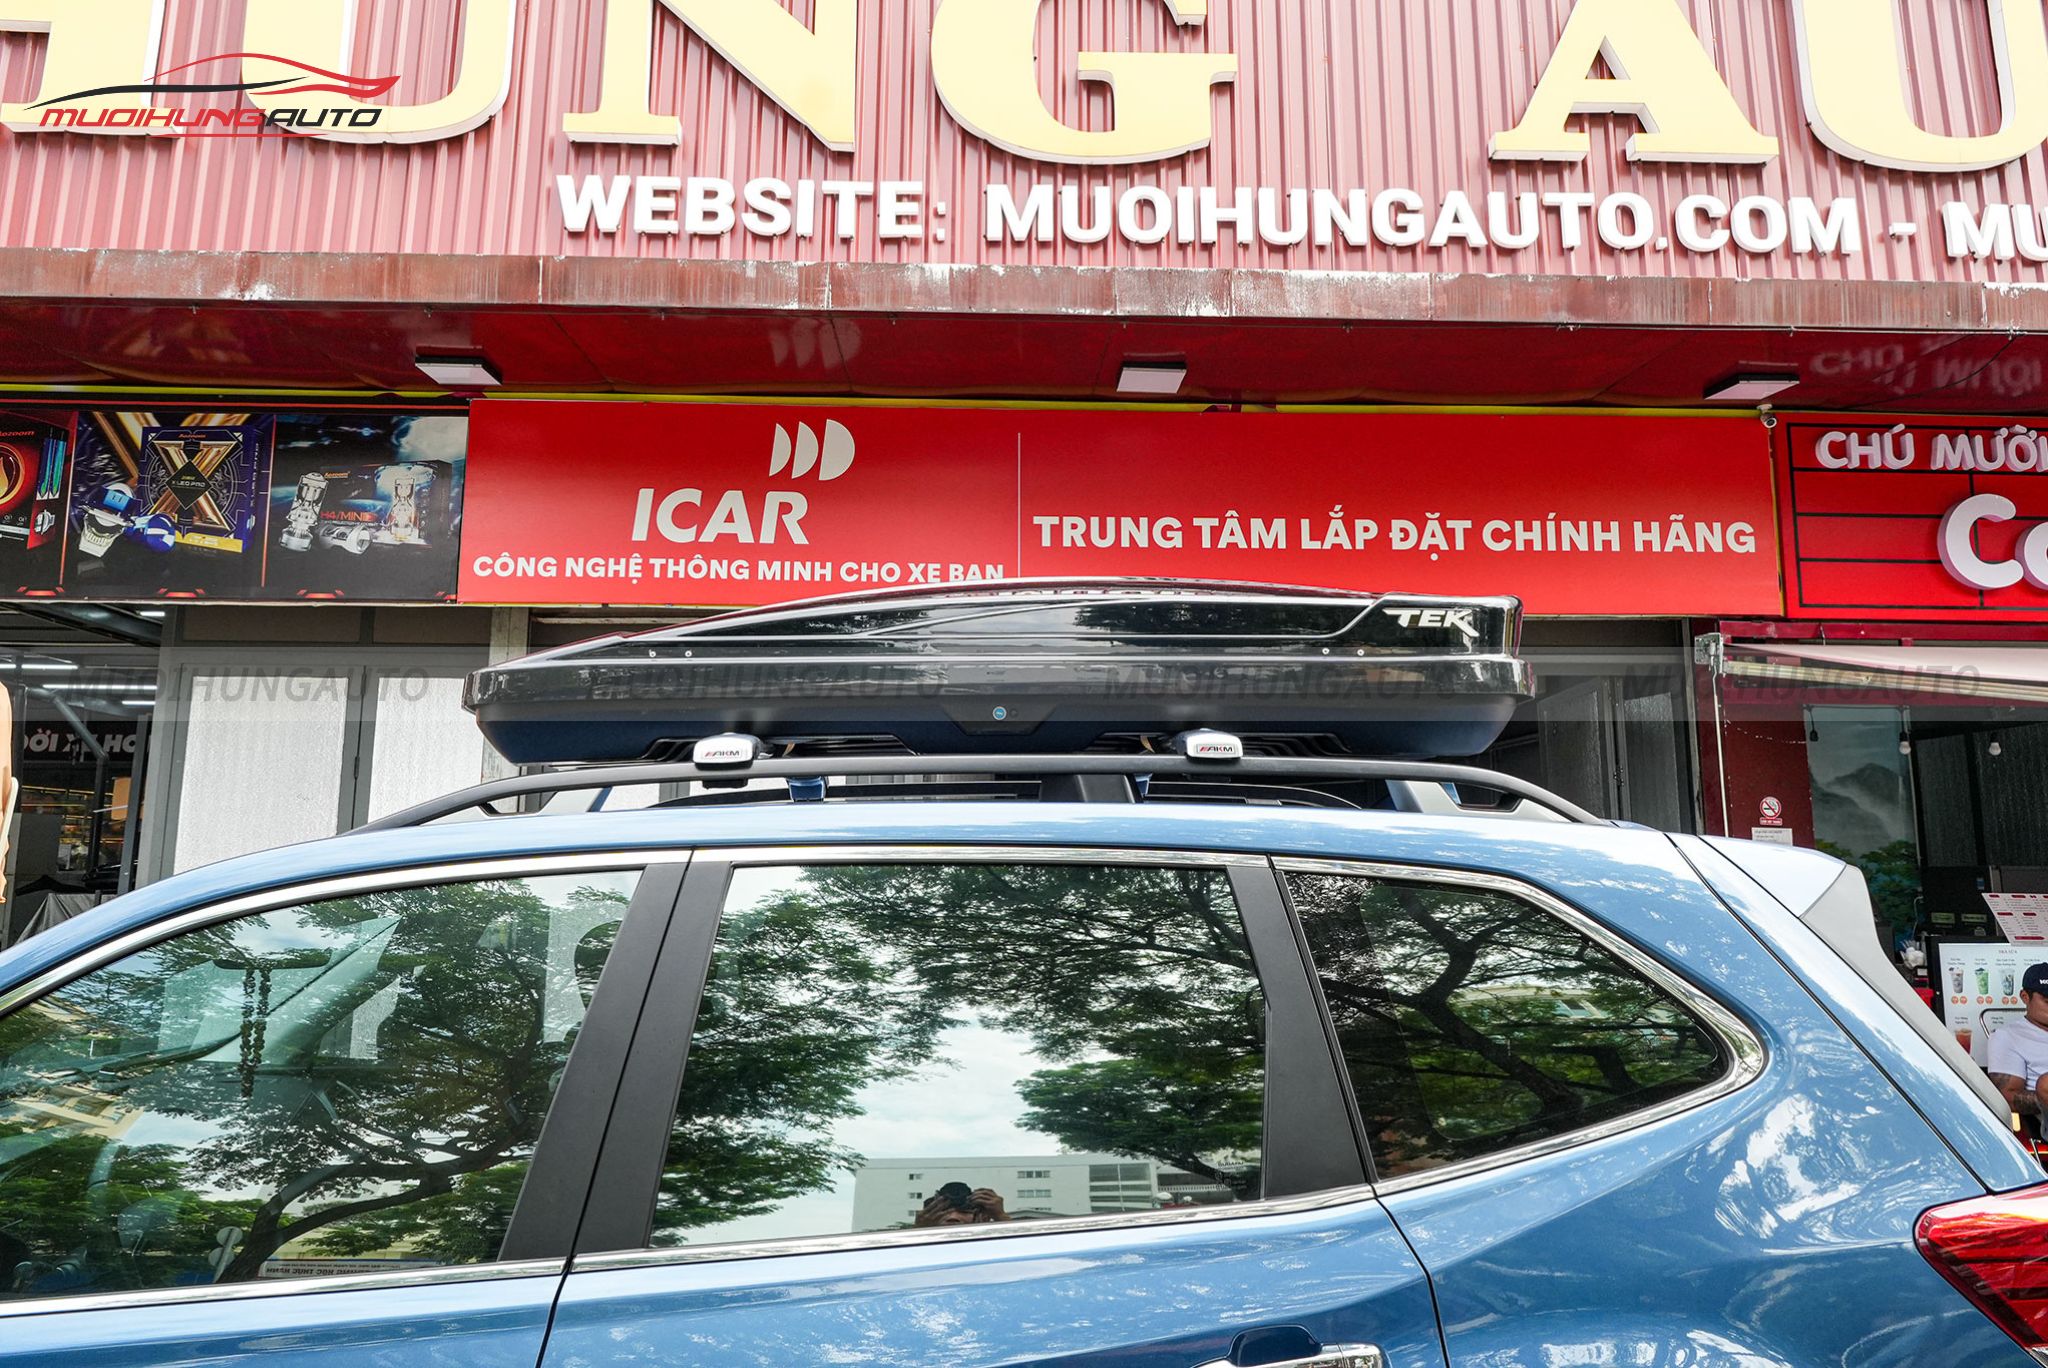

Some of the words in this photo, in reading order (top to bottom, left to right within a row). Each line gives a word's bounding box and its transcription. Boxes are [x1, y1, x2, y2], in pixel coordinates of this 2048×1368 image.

[556, 174, 946, 242] WEBSITE:
[984, 183, 1862, 255] MUOIHUNGAUTO.COM
[1942, 201, 2048, 262] MU
[1815, 423, 1915, 469] CHÚ
[632, 488, 809, 544] ICAR
[1033, 515, 1183, 550] TRUNG
[1194, 511, 1287, 550] TÂM
[1301, 505, 1378, 550] LẮP
[1389, 512, 1472, 561] ĐẶT
[1481, 511, 1620, 552] CHÍNH
[1634, 514, 1756, 553] HÃNG
[473, 552, 558, 578] CÔNG
[565, 553, 642, 584] NGHỆ
[649, 554, 749, 580] THÔNG
[757, 561, 832, 582] MINH
[840, 562, 901, 583] CHO
[908, 563, 941, 583] XE
[1382, 607, 1480, 637] TEK
